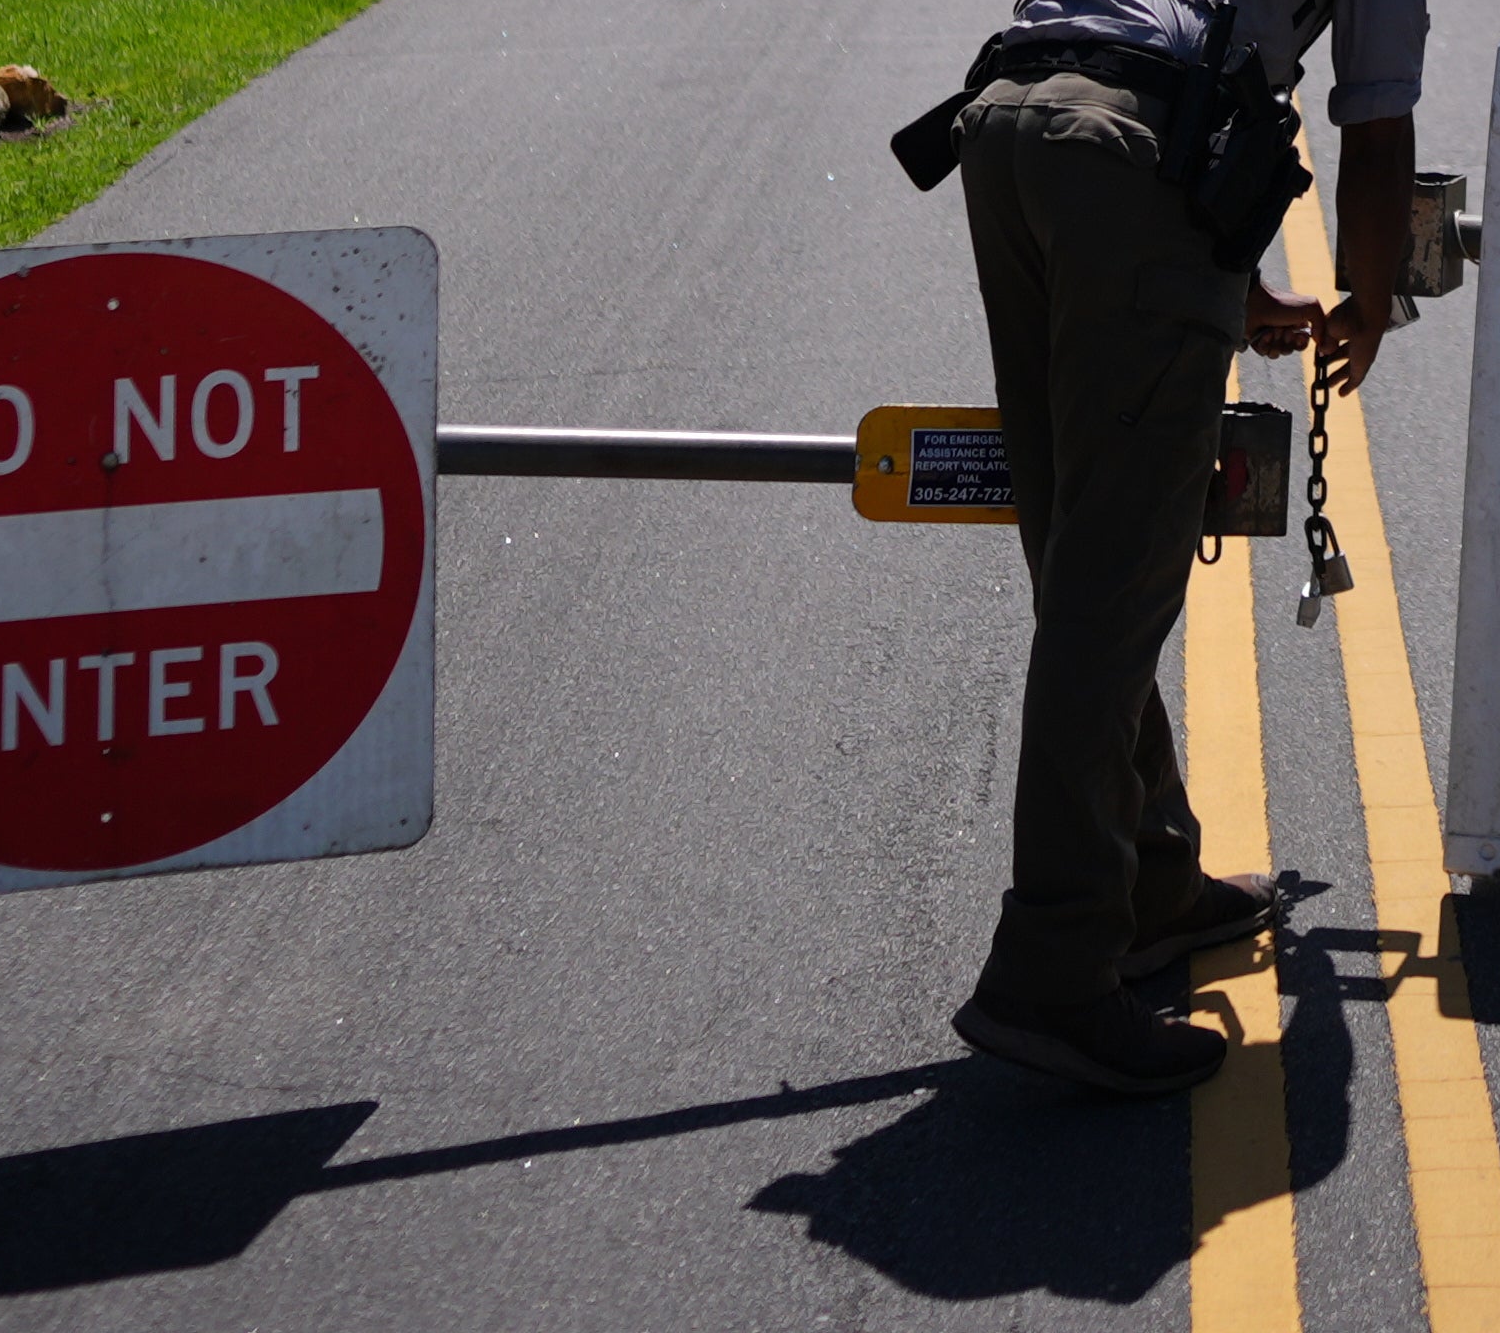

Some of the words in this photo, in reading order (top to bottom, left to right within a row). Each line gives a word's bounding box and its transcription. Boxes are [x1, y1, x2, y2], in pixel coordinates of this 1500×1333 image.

[112, 365, 320, 467] NOT
[924, 434, 947, 445] FOR
[949, 434, 1005, 445] EMERGEN
[919, 447, 987, 458] ASSISTANCE
[988, 447, 1005, 458] OR
[914, 460, 960, 471] REPORT
[956, 474, 982, 484] DIAL
[914, 487, 1016, 502] 305-247-727
